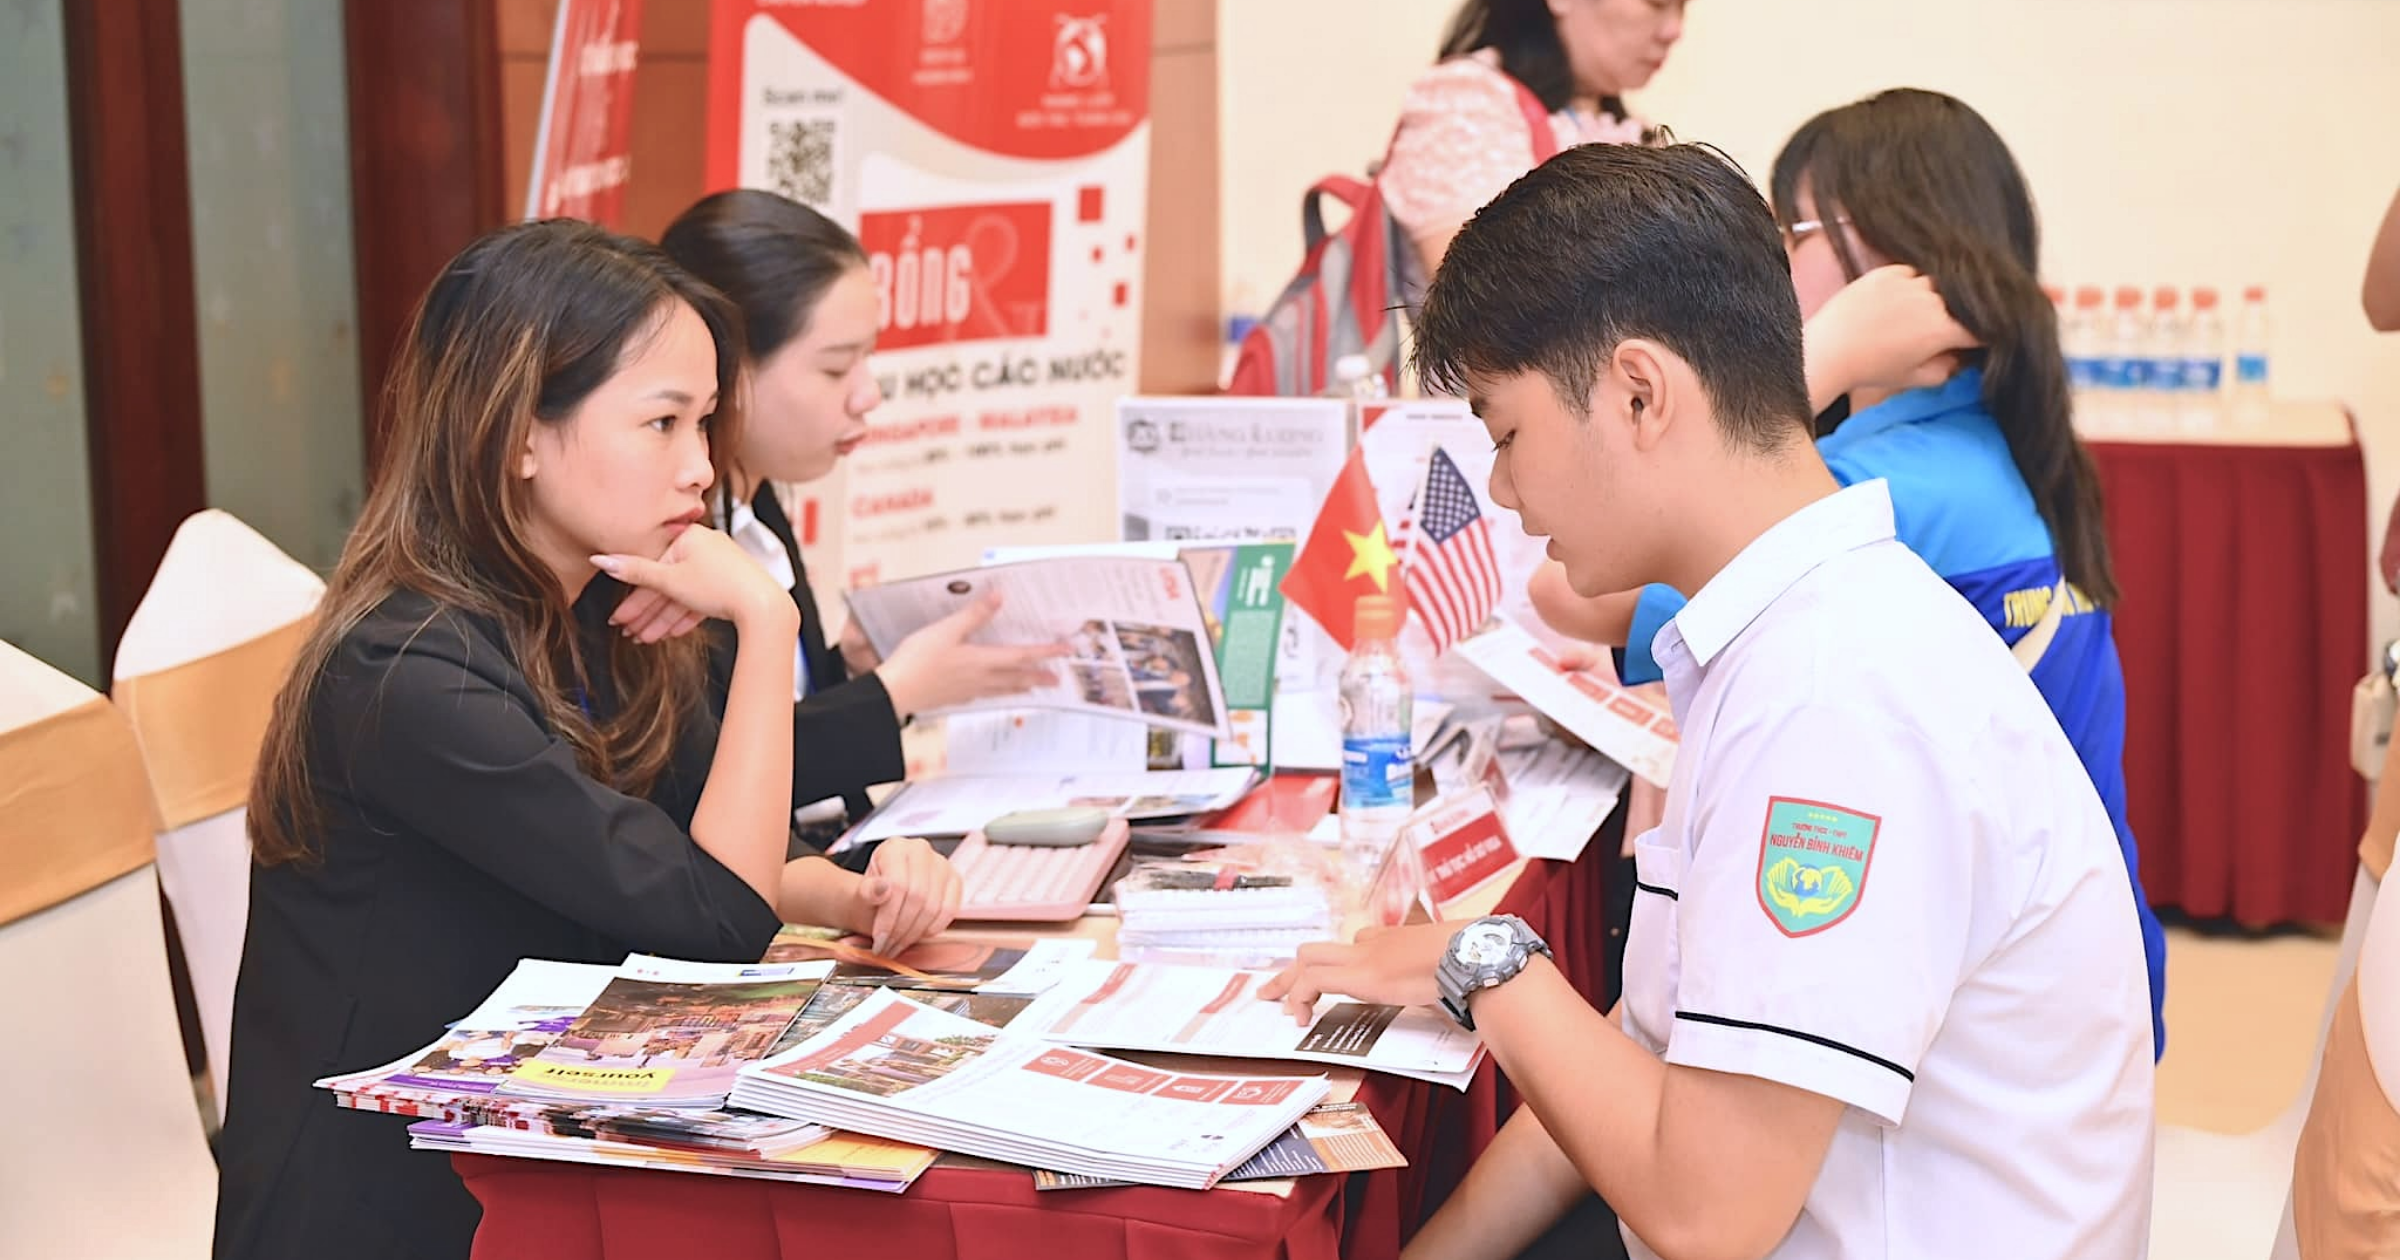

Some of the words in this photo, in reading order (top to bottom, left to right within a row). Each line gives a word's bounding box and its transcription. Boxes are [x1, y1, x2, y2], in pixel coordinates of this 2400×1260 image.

[905, 363, 961, 398] HỌC
[972, 350, 1038, 389] CÁC
[1049, 347, 1125, 381] NƯỚC
[864, 413, 959, 445] INGAPORE
[1770, 832, 1805, 849] NGUYỄN
[1831, 844, 1864, 862] KHIÊM
[544, 1067, 656, 1079] yourself
